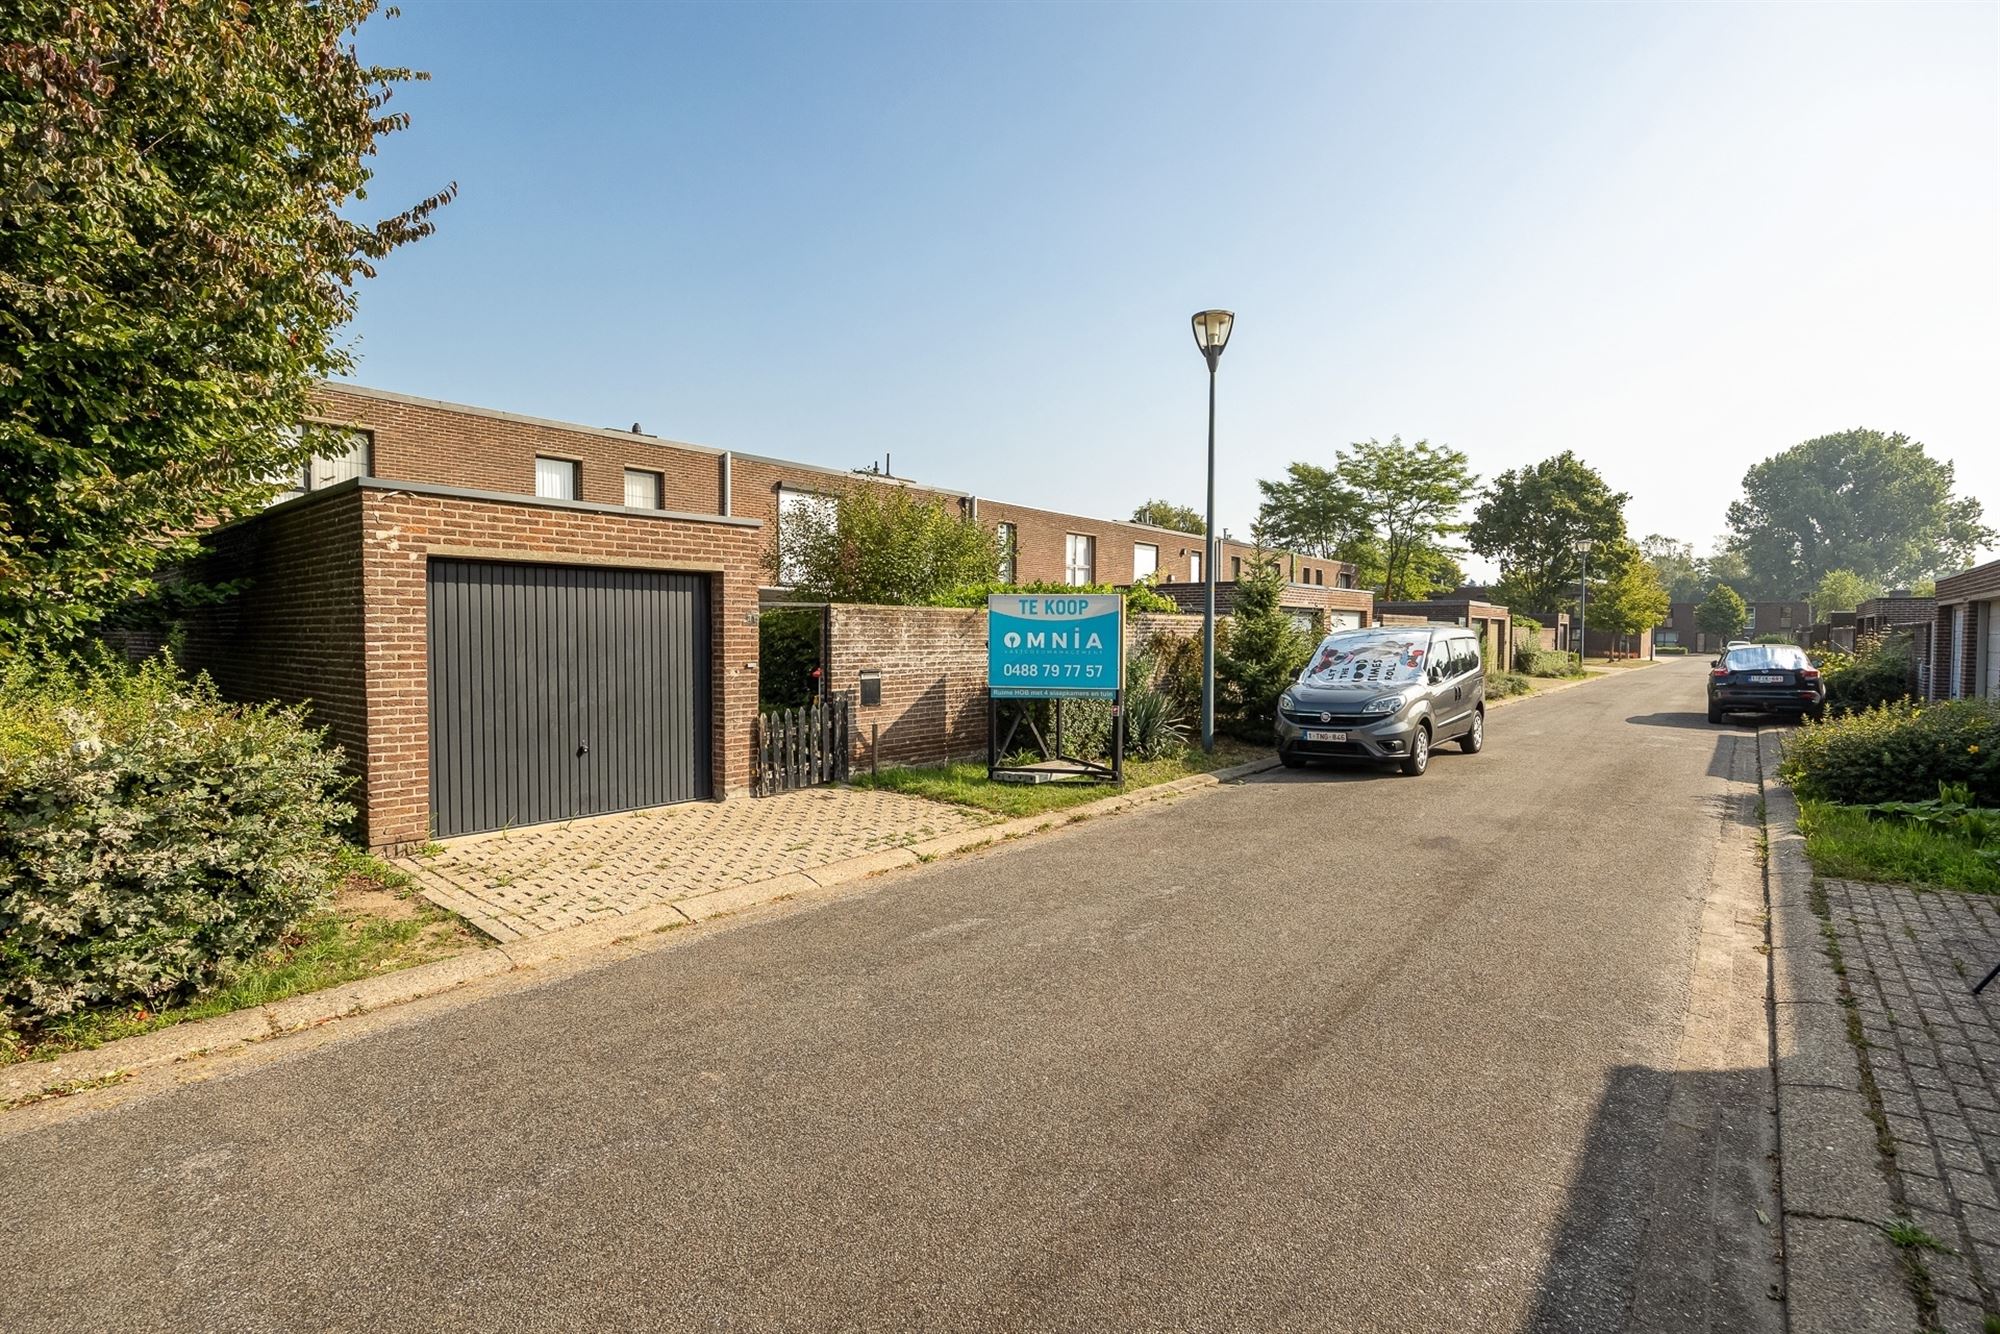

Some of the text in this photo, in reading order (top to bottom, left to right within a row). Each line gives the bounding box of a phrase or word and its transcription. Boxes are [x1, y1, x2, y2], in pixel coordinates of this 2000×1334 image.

[1018, 599, 1089, 615] TE KOOP
[1003, 664, 1103, 678] 0488 79 77 57
[1327, 669, 1337, 680] LET
[1339, 667, 1350, 679] THE
[1368, 659, 1383, 682] TIMES
[1384, 663, 1397, 681] ROLL
